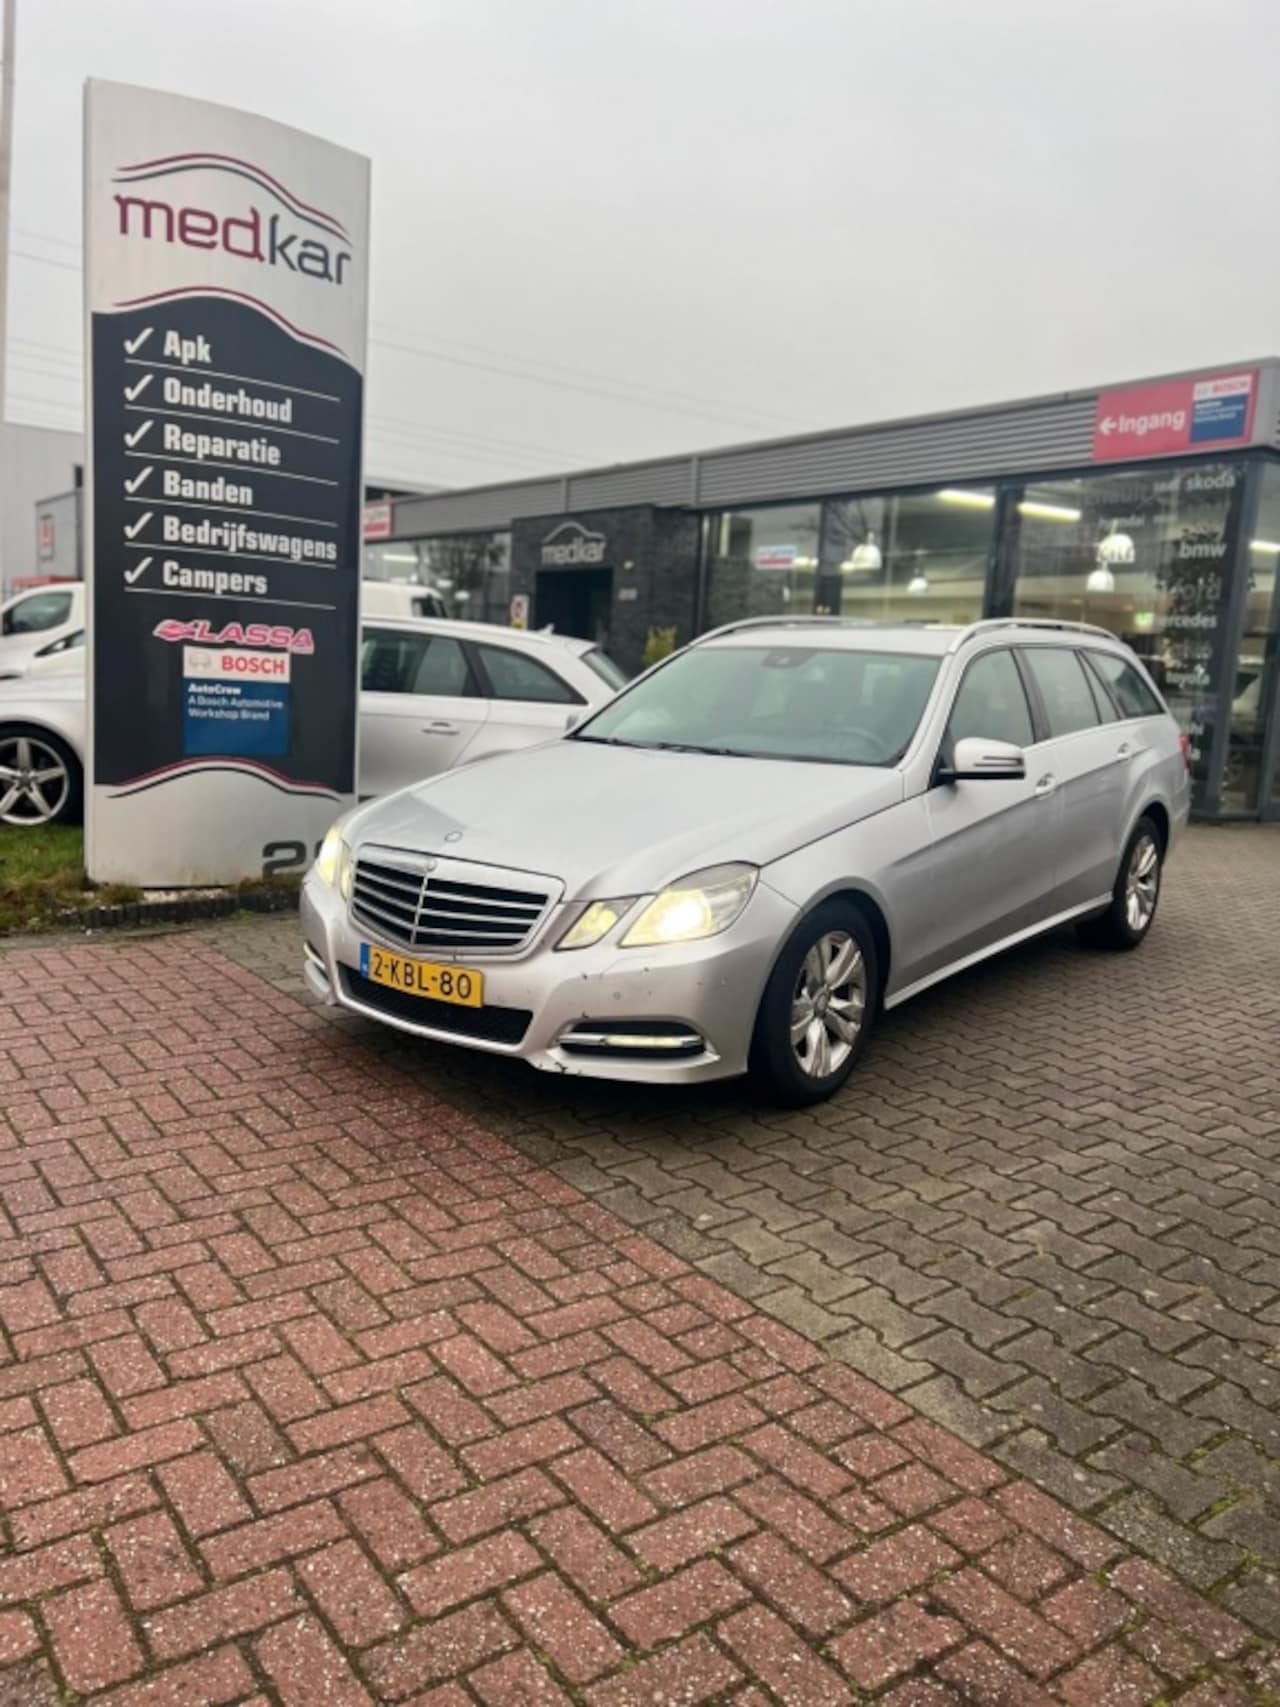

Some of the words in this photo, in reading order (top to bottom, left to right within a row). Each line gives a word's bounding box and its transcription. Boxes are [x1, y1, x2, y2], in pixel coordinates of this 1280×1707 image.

[113, 194, 351, 285] medkar
[163, 330, 212, 365] Apk
[163, 377, 292, 424] Onderhoud
[1118, 410, 1185, 436] Ingang
[163, 423, 281, 465] Reparatie
[163, 470, 253, 505] Banden
[163, 515, 337, 560] Bedrijfswagens
[1179, 541, 1227, 558] bmw
[163, 560, 267, 595] Campers
[196, 620, 314, 654] LASSA
[221, 655, 285, 674] BOSCH
[187, 695, 196, 706] A
[373, 952, 472, 1000] 2-KBL-80
